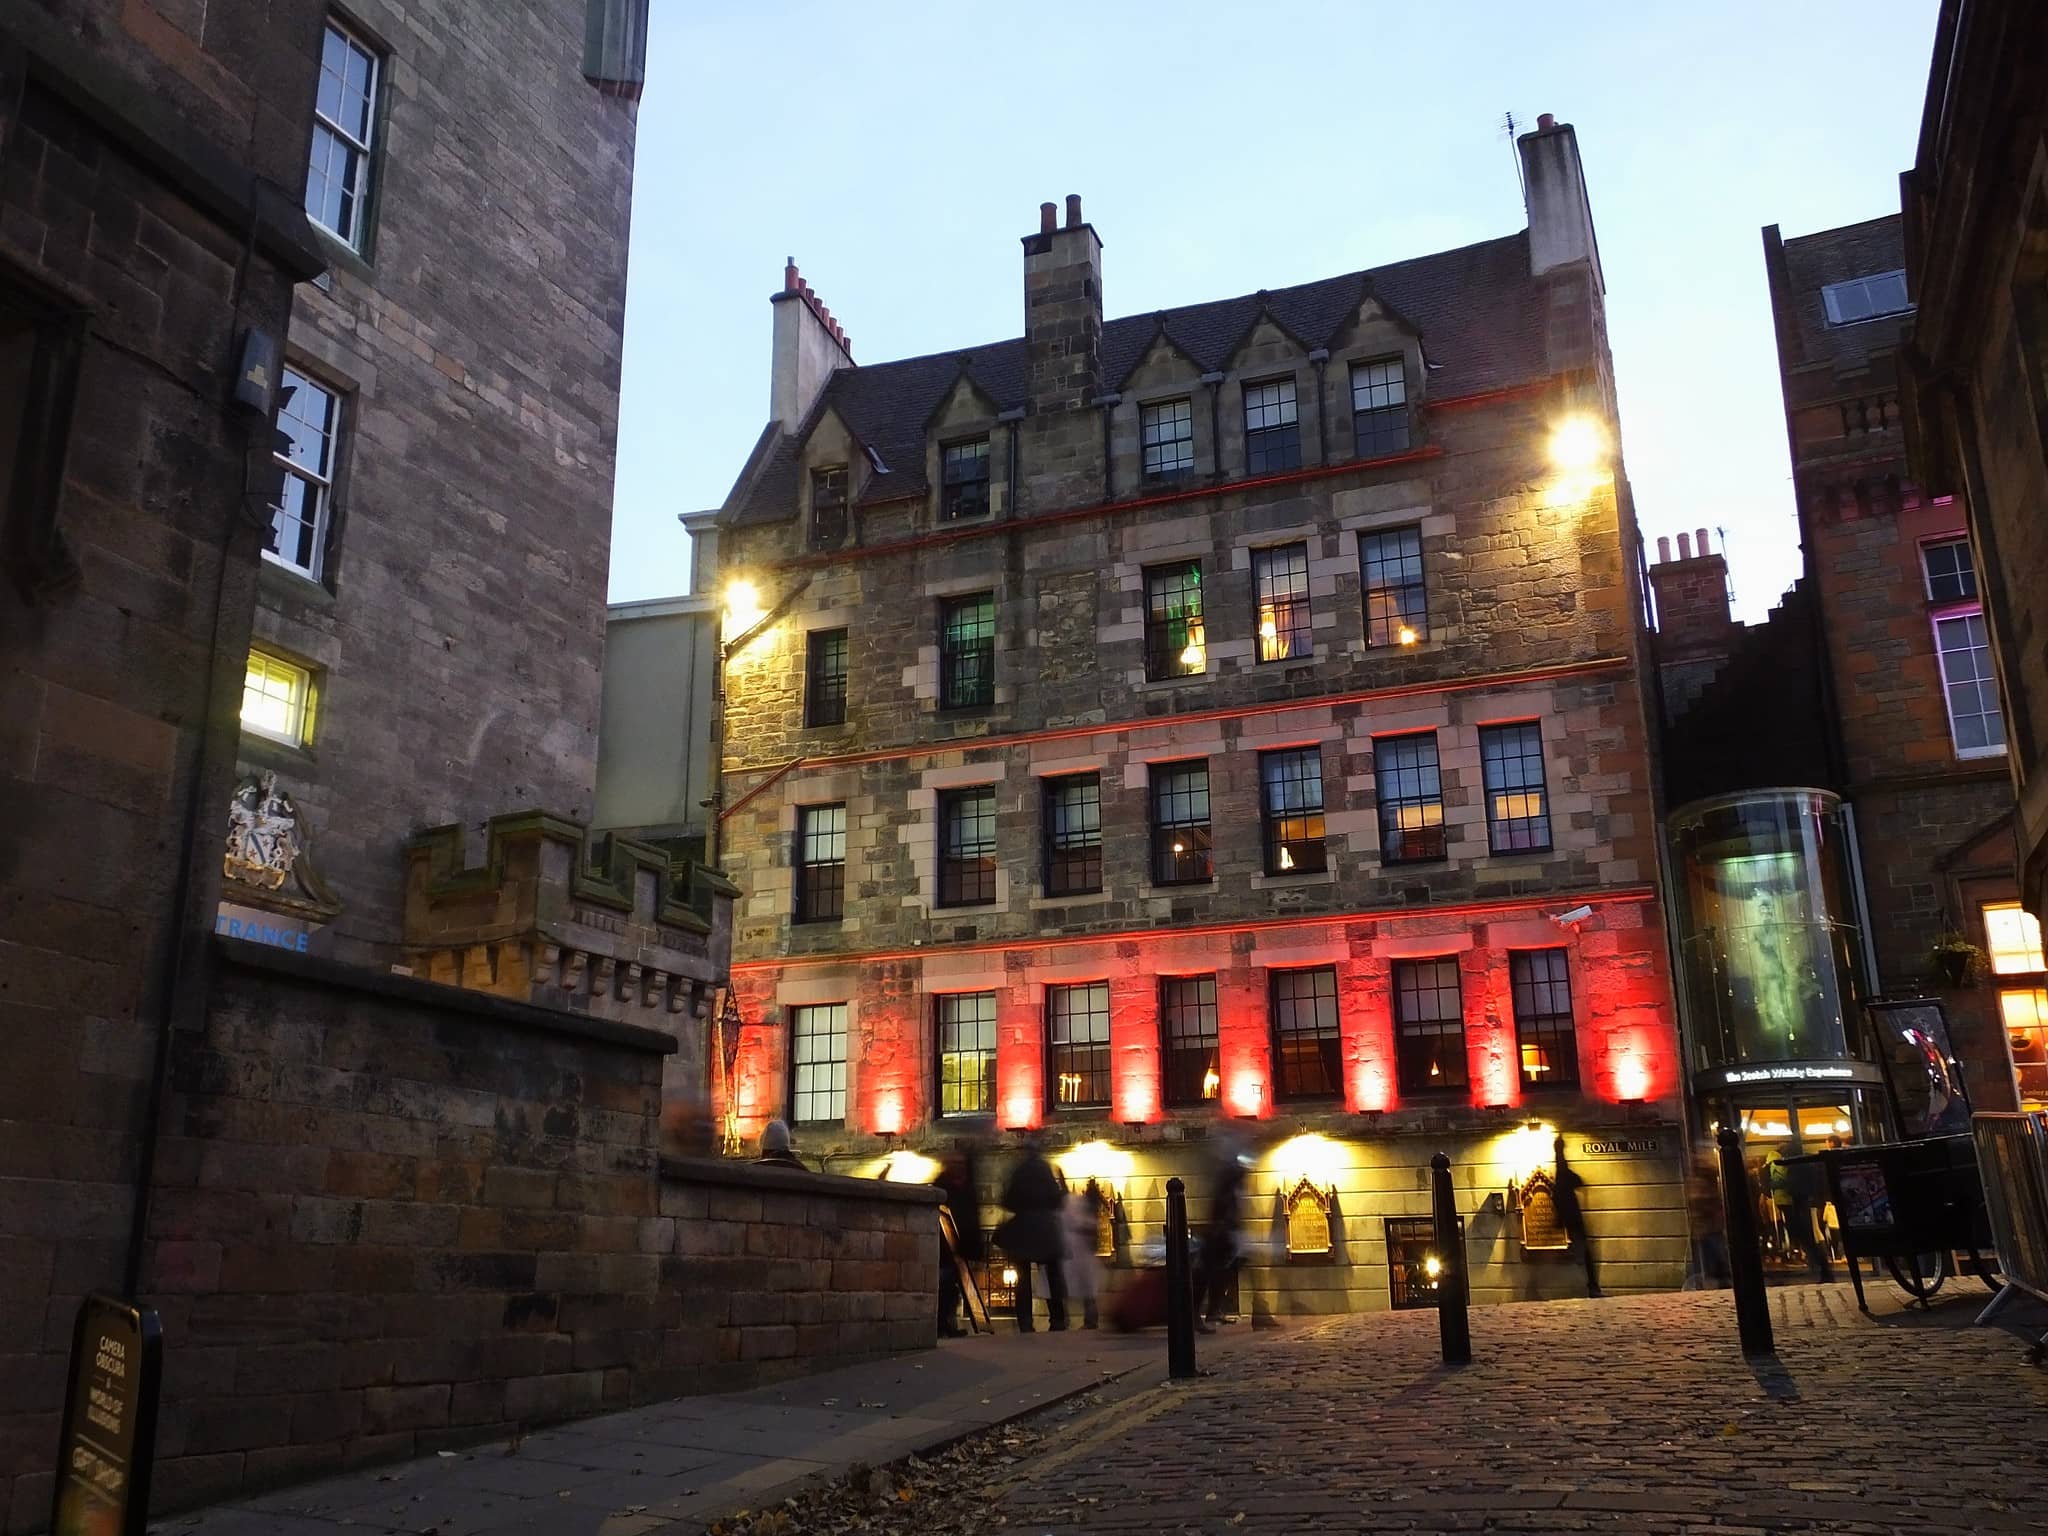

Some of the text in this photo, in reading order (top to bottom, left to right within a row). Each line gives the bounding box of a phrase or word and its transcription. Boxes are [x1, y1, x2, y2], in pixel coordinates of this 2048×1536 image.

[1584, 1140, 1656, 1153] ROYAL MILE
[99, 1335, 126, 1360] CAMERA
[95, 1351, 126, 1378] OBSCURA
